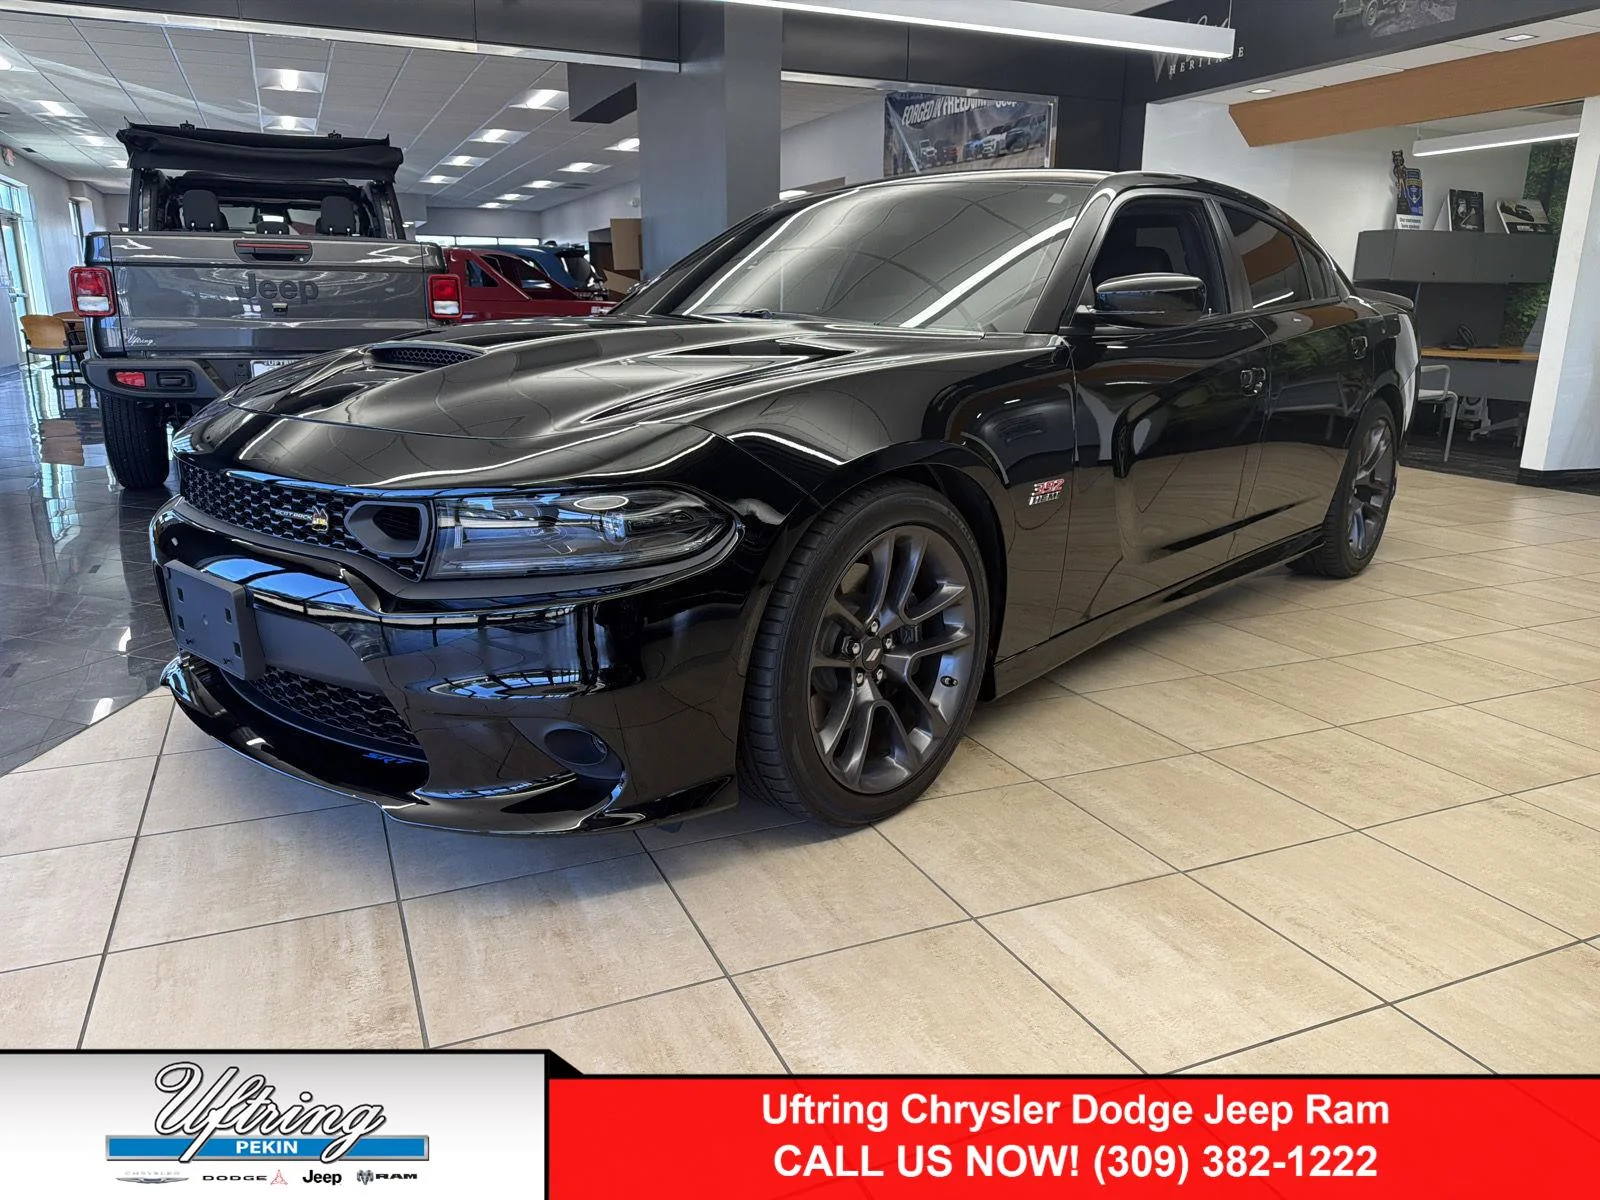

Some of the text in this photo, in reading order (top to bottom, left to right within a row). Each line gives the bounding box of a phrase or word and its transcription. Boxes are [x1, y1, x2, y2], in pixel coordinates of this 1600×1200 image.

[901, 100, 935, 126] FORGED
[932, 97, 943, 119] IN
[235, 273, 319, 305] Jeep
[1032, 479, 1065, 496] 392
